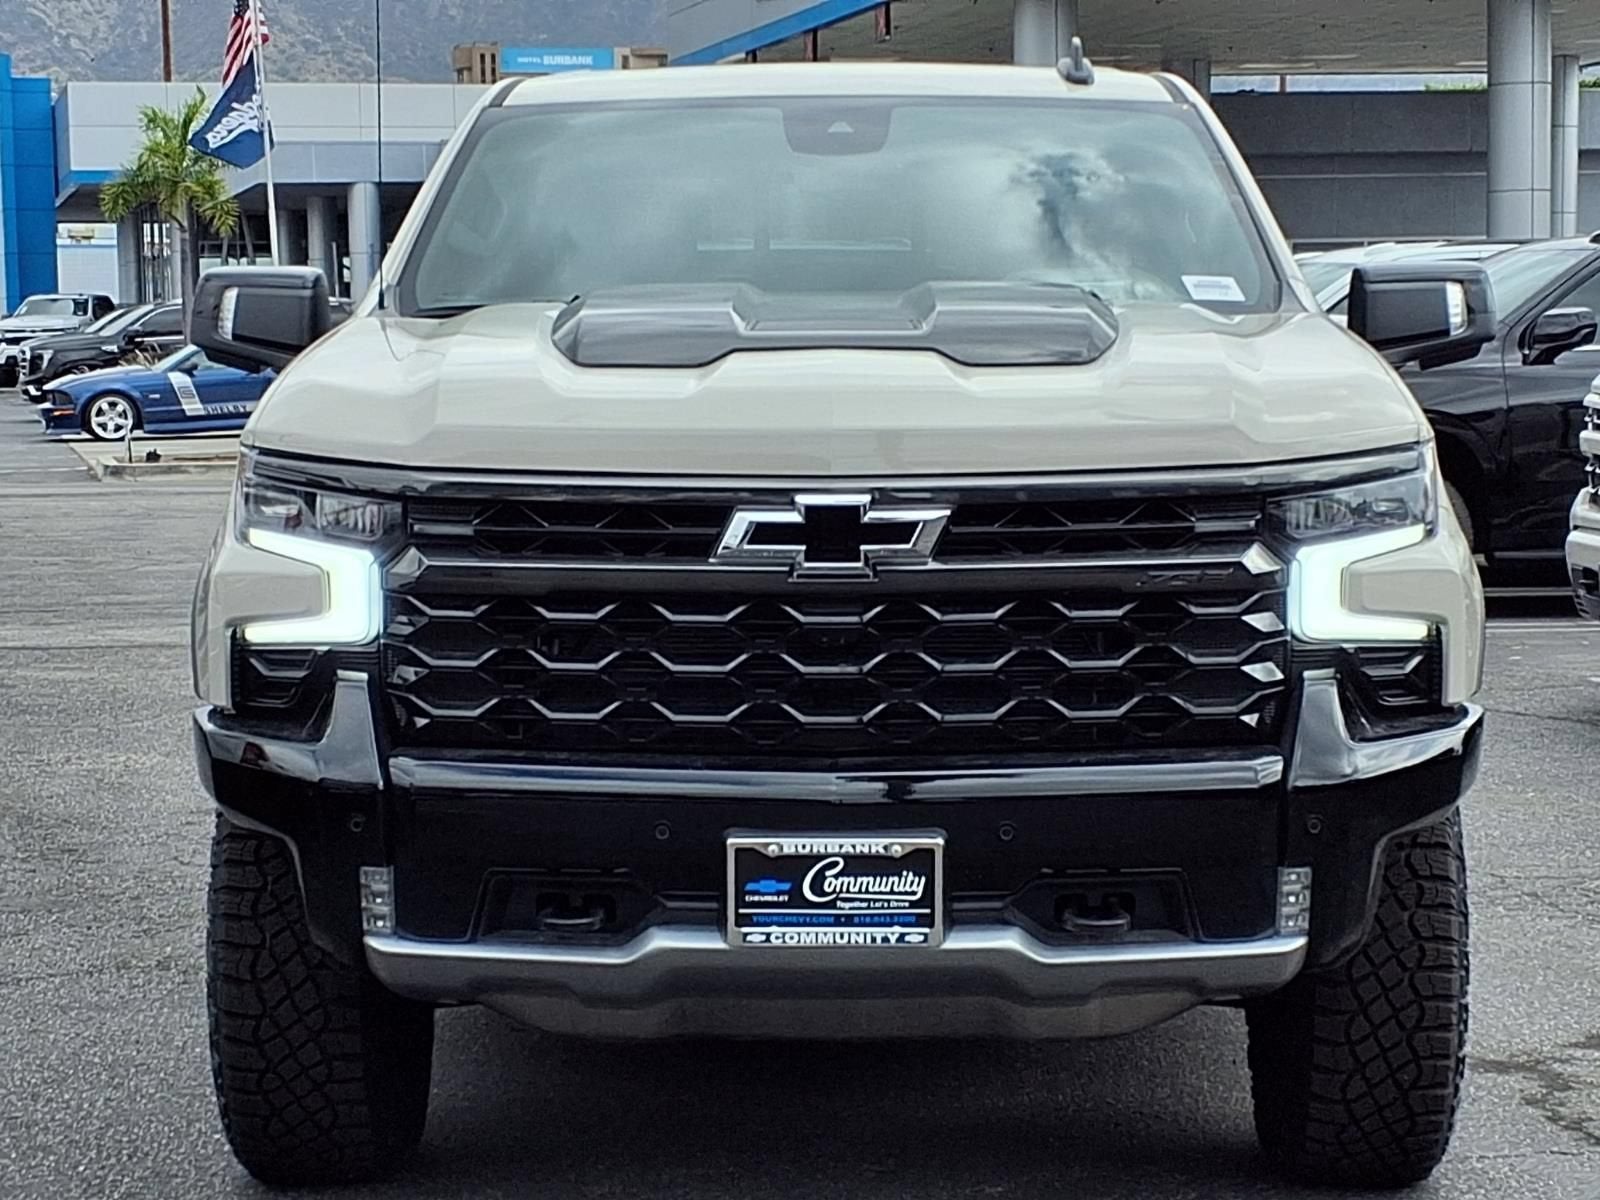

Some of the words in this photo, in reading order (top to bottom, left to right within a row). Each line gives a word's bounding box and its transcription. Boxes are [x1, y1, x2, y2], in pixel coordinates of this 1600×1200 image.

[543, 55, 593, 65] BURBANK
[783, 843, 886, 854] BURBANK
[802, 856, 926, 903] Community
[769, 932, 900, 944] COMMUNITY
